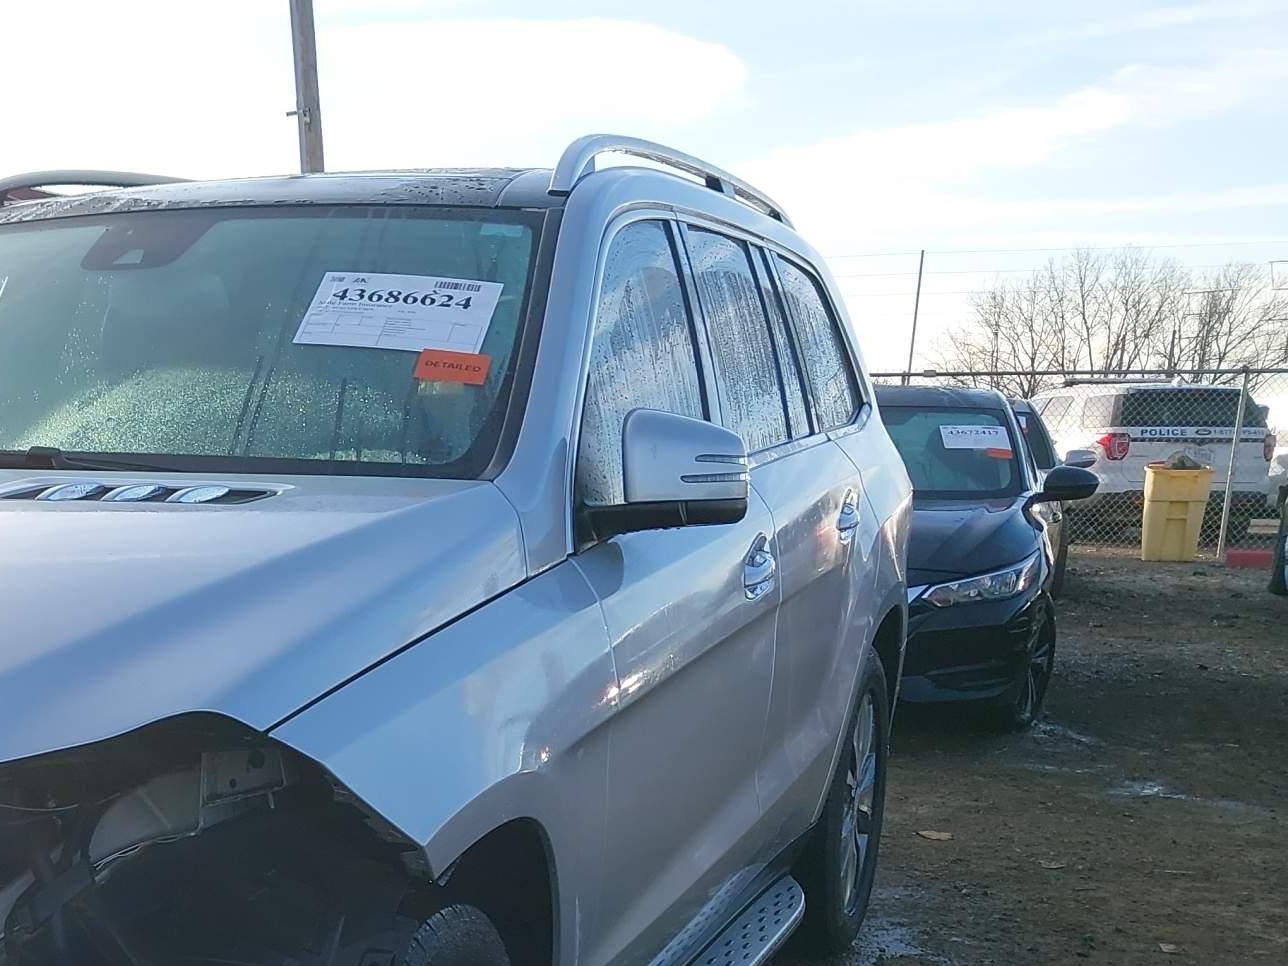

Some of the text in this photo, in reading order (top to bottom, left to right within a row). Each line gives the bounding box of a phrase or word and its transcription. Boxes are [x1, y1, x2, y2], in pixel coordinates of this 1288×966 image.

[331, 287, 473, 310] 43686624
[424, 359, 482, 373] DETAILED
[1140, 428, 1188, 437] POLICE
